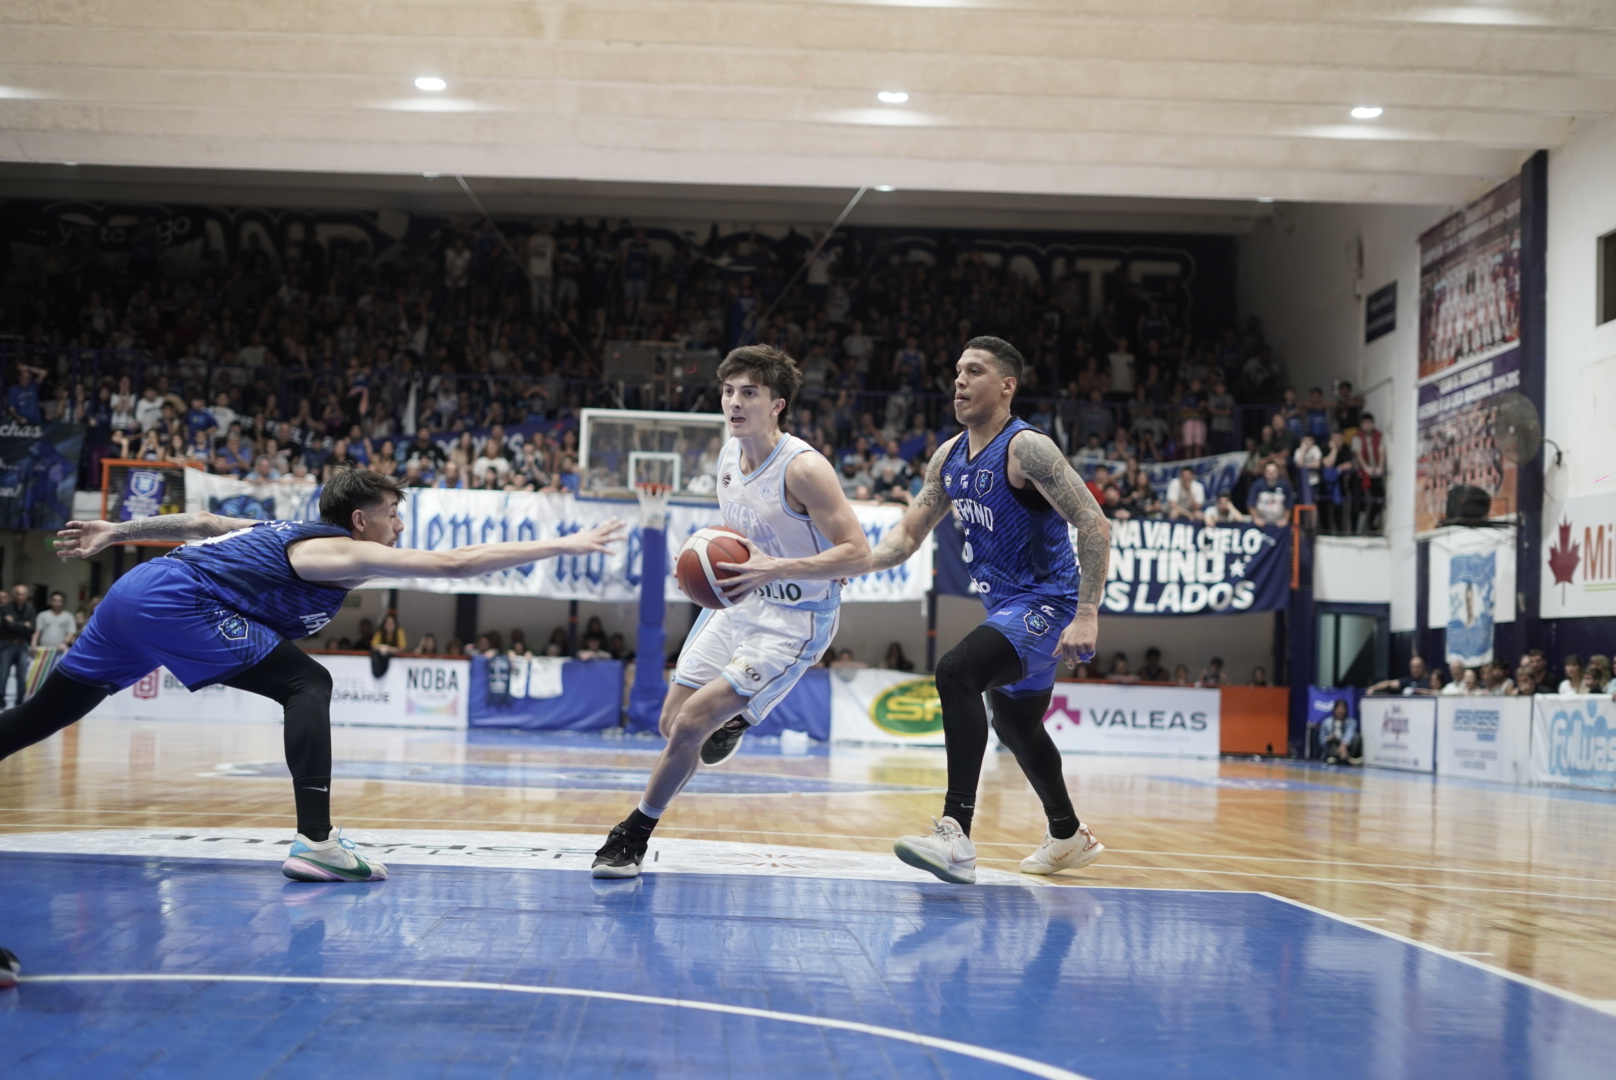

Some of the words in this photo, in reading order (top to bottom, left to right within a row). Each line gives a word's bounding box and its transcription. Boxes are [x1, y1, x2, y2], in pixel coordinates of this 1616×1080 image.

[1197, 526, 1263, 555] CIELO
[1583, 523, 1616, 581] Mi
[1106, 548, 1226, 584] NTINO
[1134, 580, 1256, 613] LADOS
[406, 667, 459, 690] NOBA
[331, 689, 391, 705] OPAHUE
[1089, 707, 1208, 732] VALEAS
